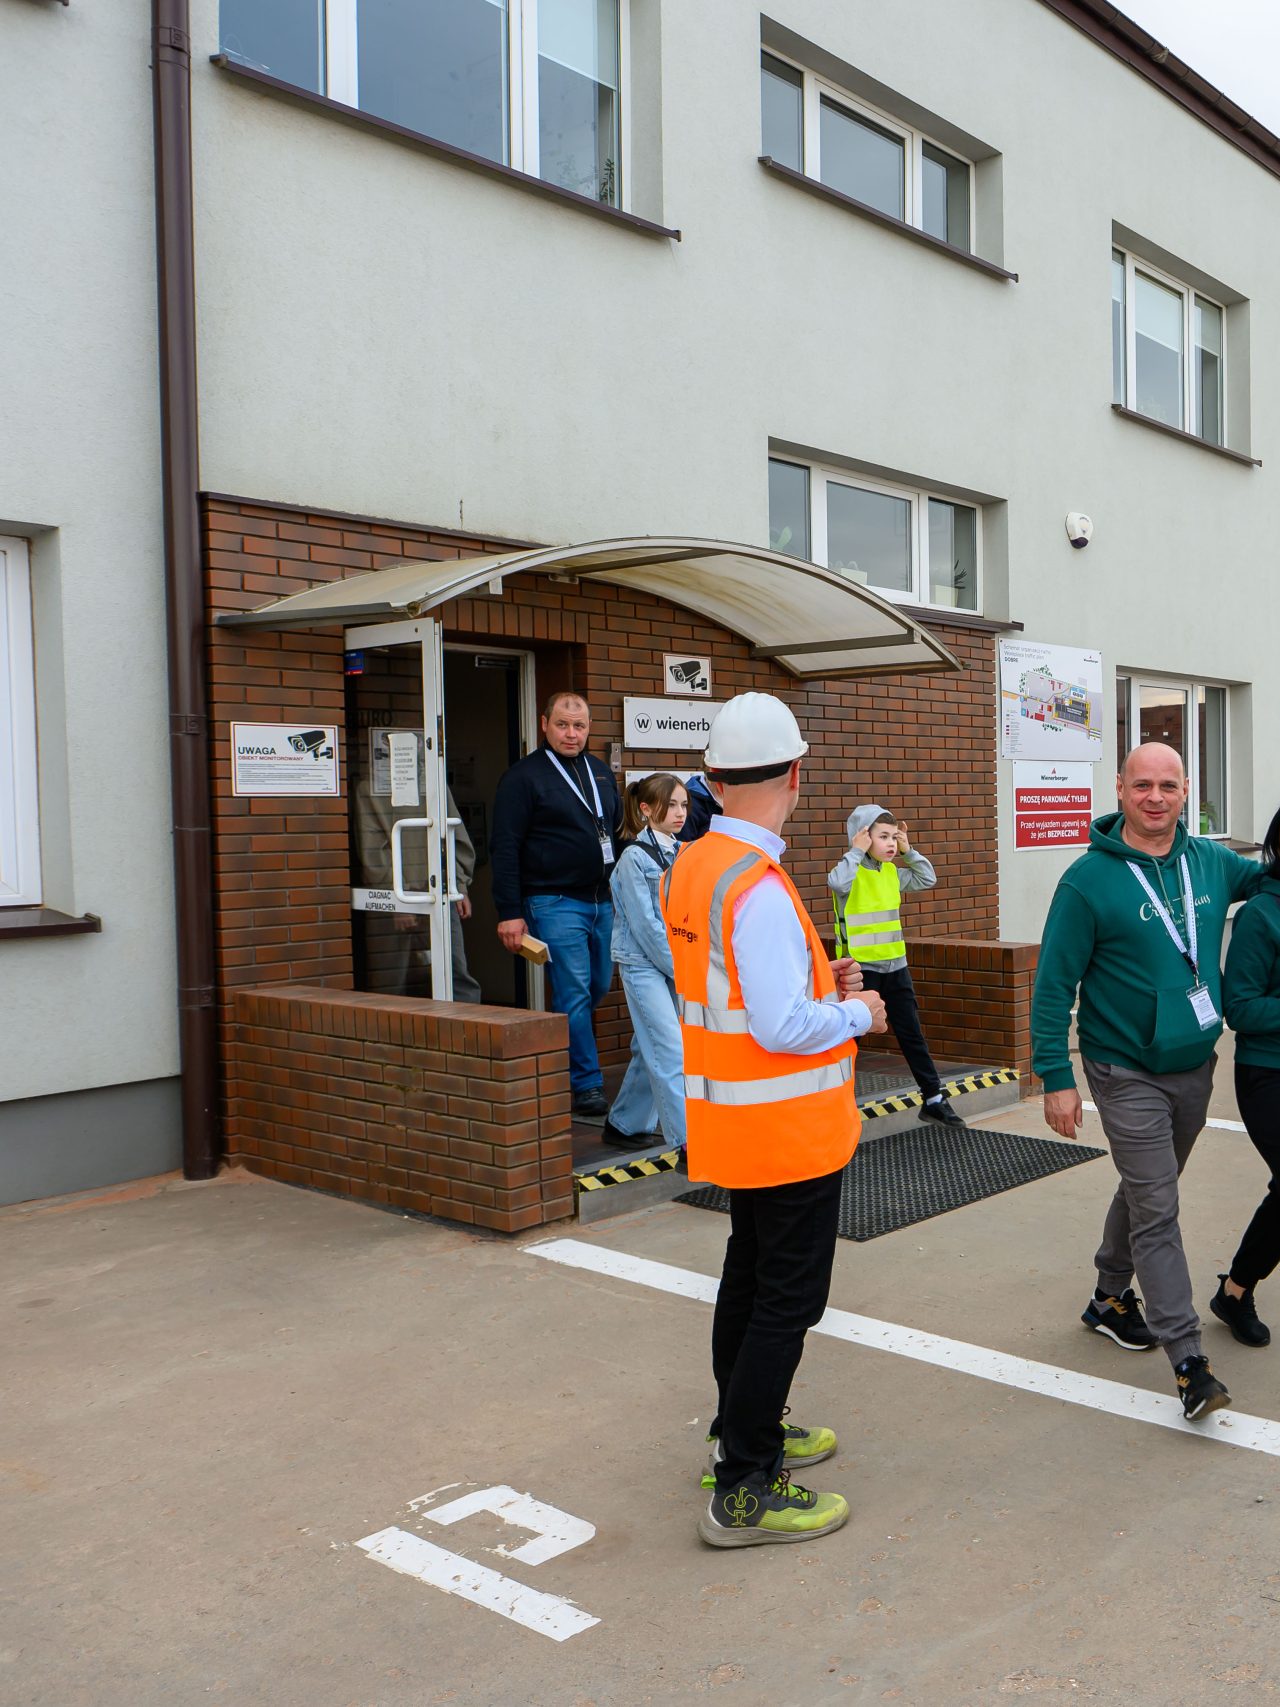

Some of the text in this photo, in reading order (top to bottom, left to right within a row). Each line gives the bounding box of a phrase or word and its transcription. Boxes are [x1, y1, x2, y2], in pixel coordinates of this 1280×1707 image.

[656, 715, 711, 732] wienerb
[237, 746, 277, 756] UWAGA
[1041, 774, 1069, 782] Wienerberger
[1019, 795, 1041, 806] PROSZĘ
[1041, 793, 1071, 804] PARKOWAĆ
[1020, 820, 1035, 829] Przed
[1035, 821, 1061, 831] wyjazdem
[1037, 830, 1047, 841] jest
[1047, 829, 1080, 838] BEZPIECZNIE
[364, 901, 397, 912] AUFMACHEN
